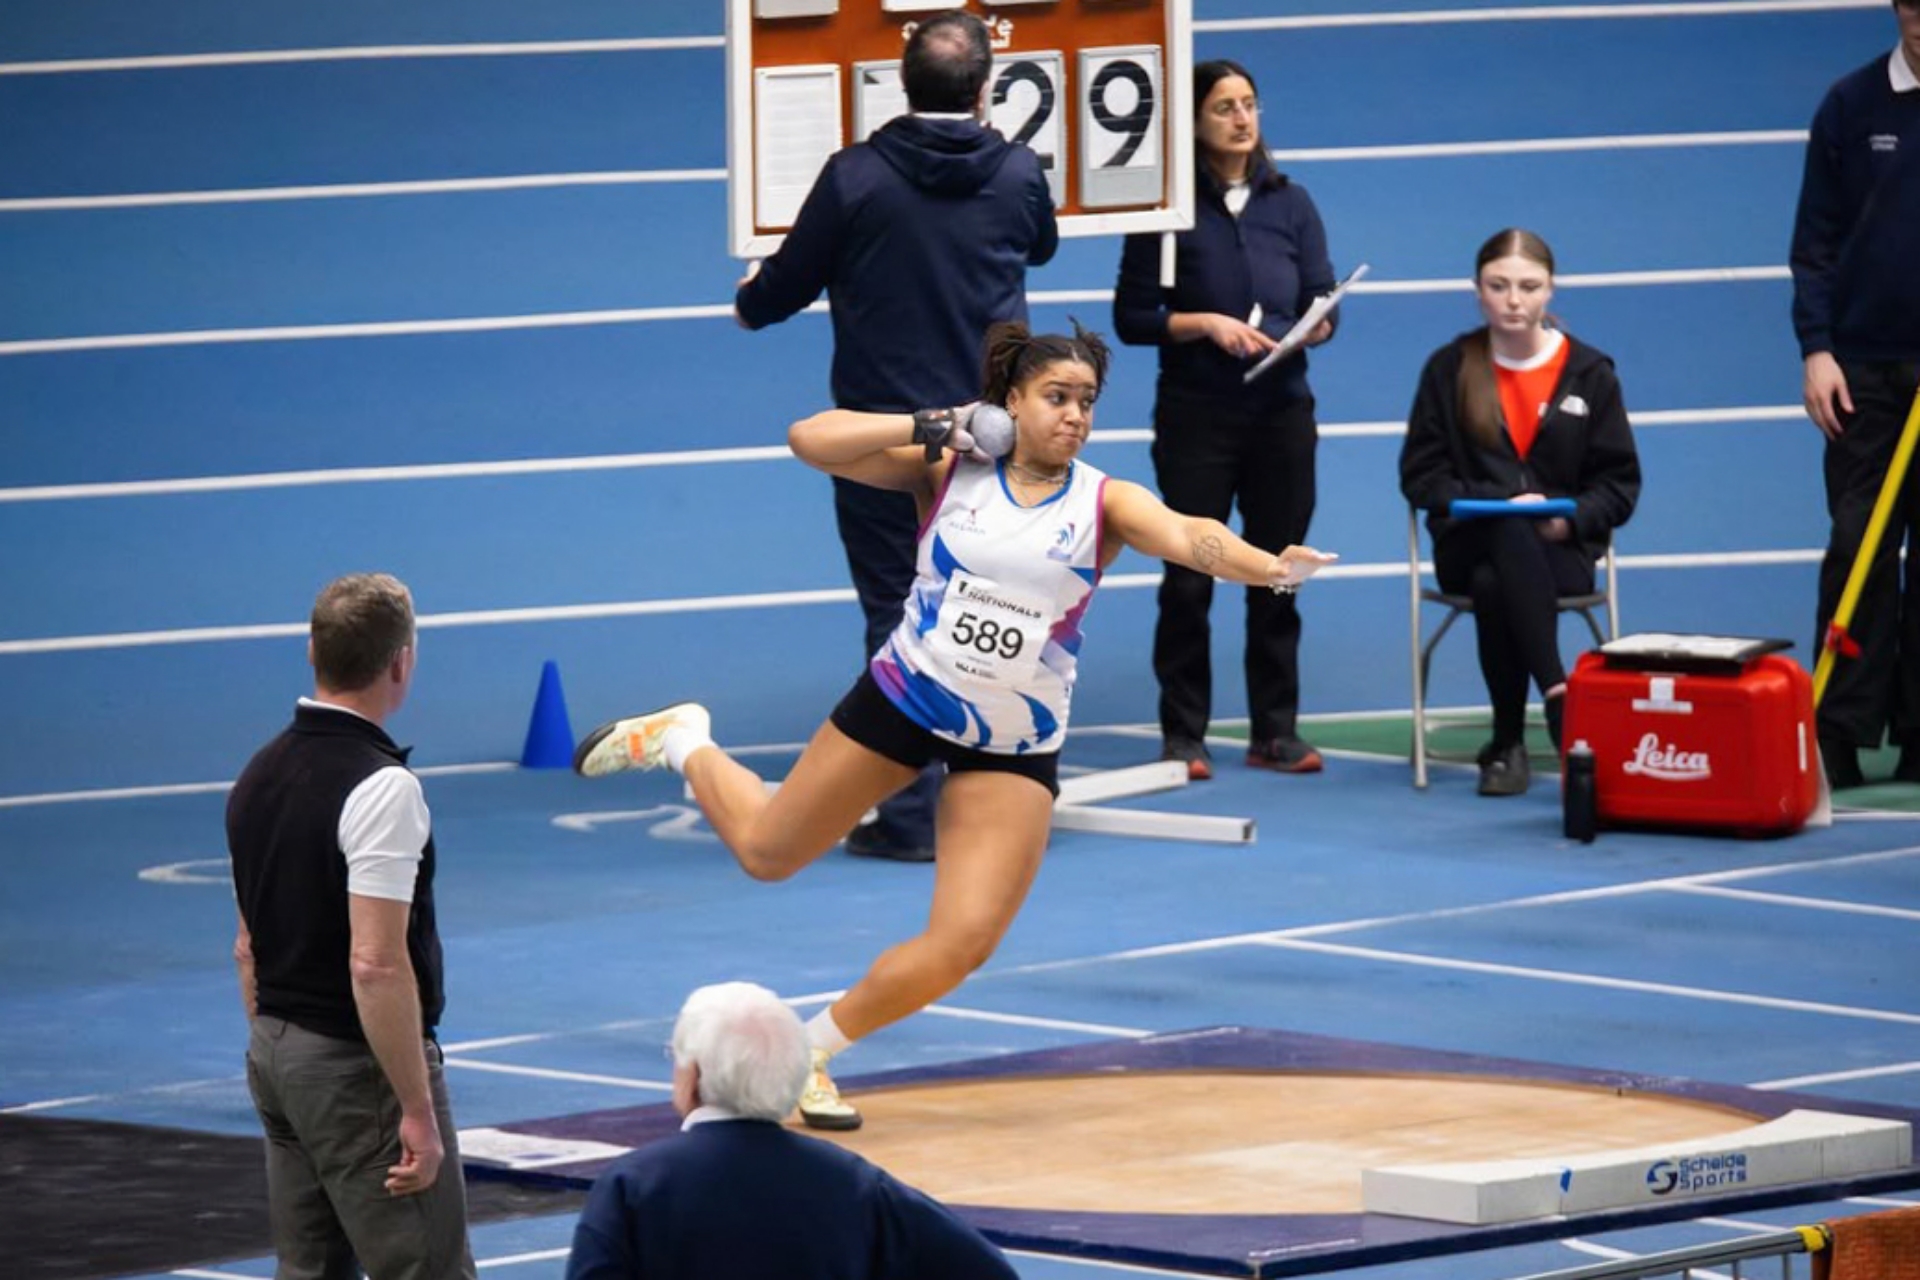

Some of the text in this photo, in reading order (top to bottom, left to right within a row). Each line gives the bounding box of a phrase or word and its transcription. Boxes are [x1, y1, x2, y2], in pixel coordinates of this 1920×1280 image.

[1089, 60, 1154, 168] 9
[968, 591, 1041, 618] NATIONALS
[952, 612, 1023, 659] 589
[1623, 733, 1710, 779] Leica
[1680, 1169, 1746, 1192] Sports
